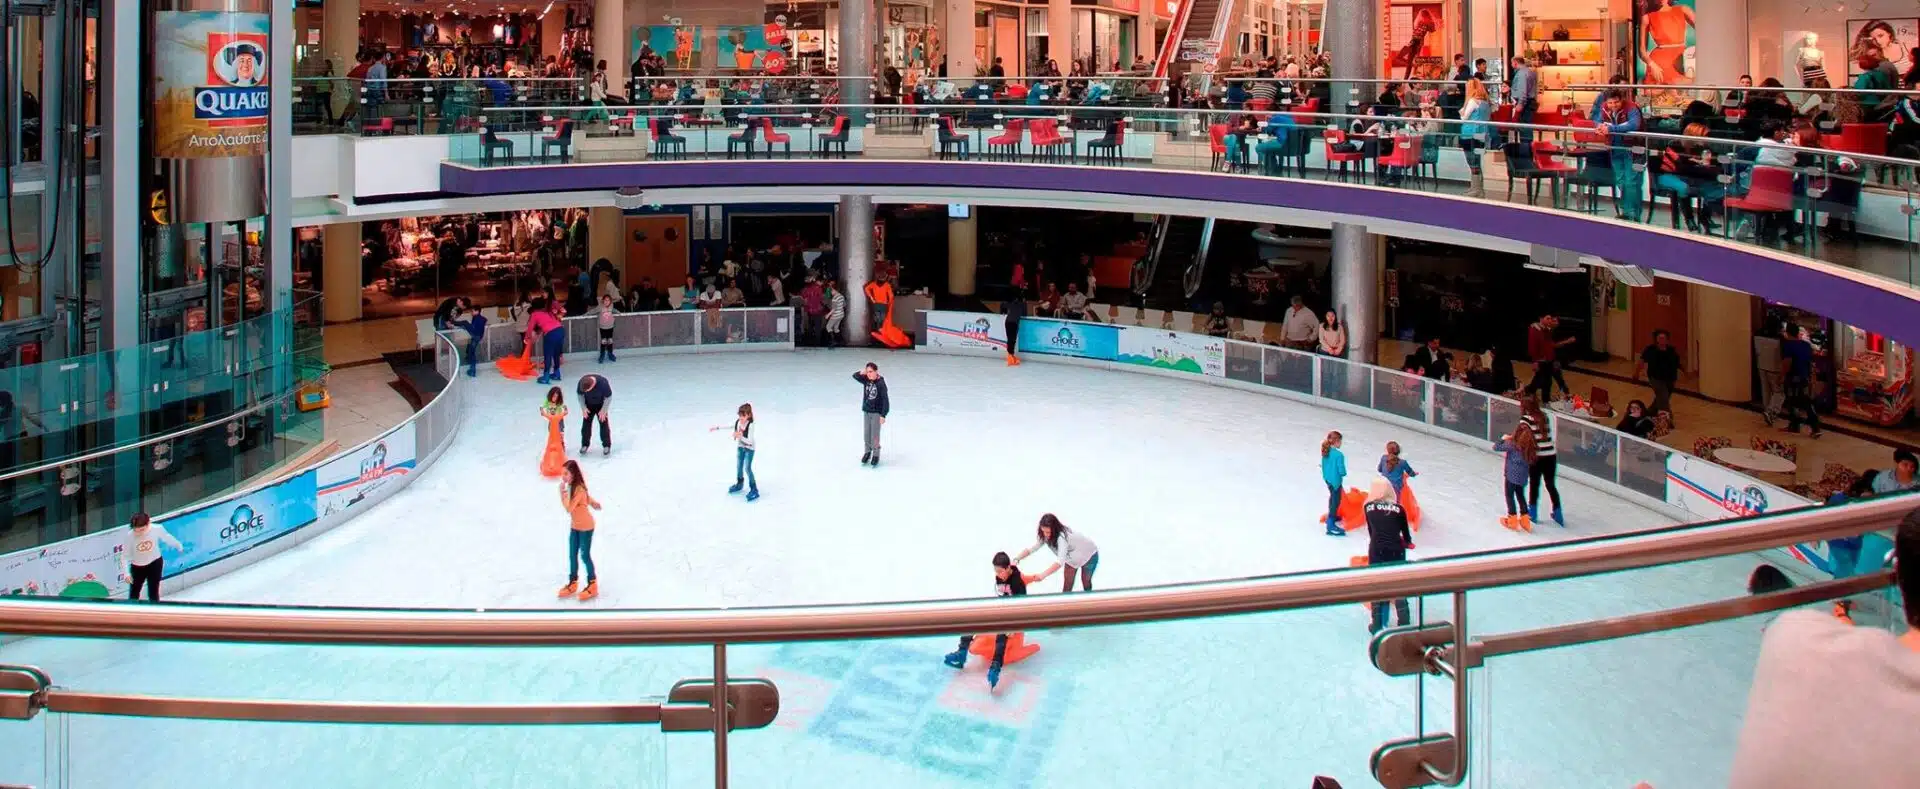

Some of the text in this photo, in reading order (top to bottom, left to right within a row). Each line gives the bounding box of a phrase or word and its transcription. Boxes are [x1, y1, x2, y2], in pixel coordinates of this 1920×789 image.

[765, 29, 785, 40] SALE
[196, 90, 268, 116] QUAKE
[189, 133, 261, 146] Απολαύστε
[1051, 335, 1080, 347] CHOICE
[360, 455, 385, 476] HIT
[1724, 484, 1763, 510] HIT
[220, 513, 264, 540] CHOICE
